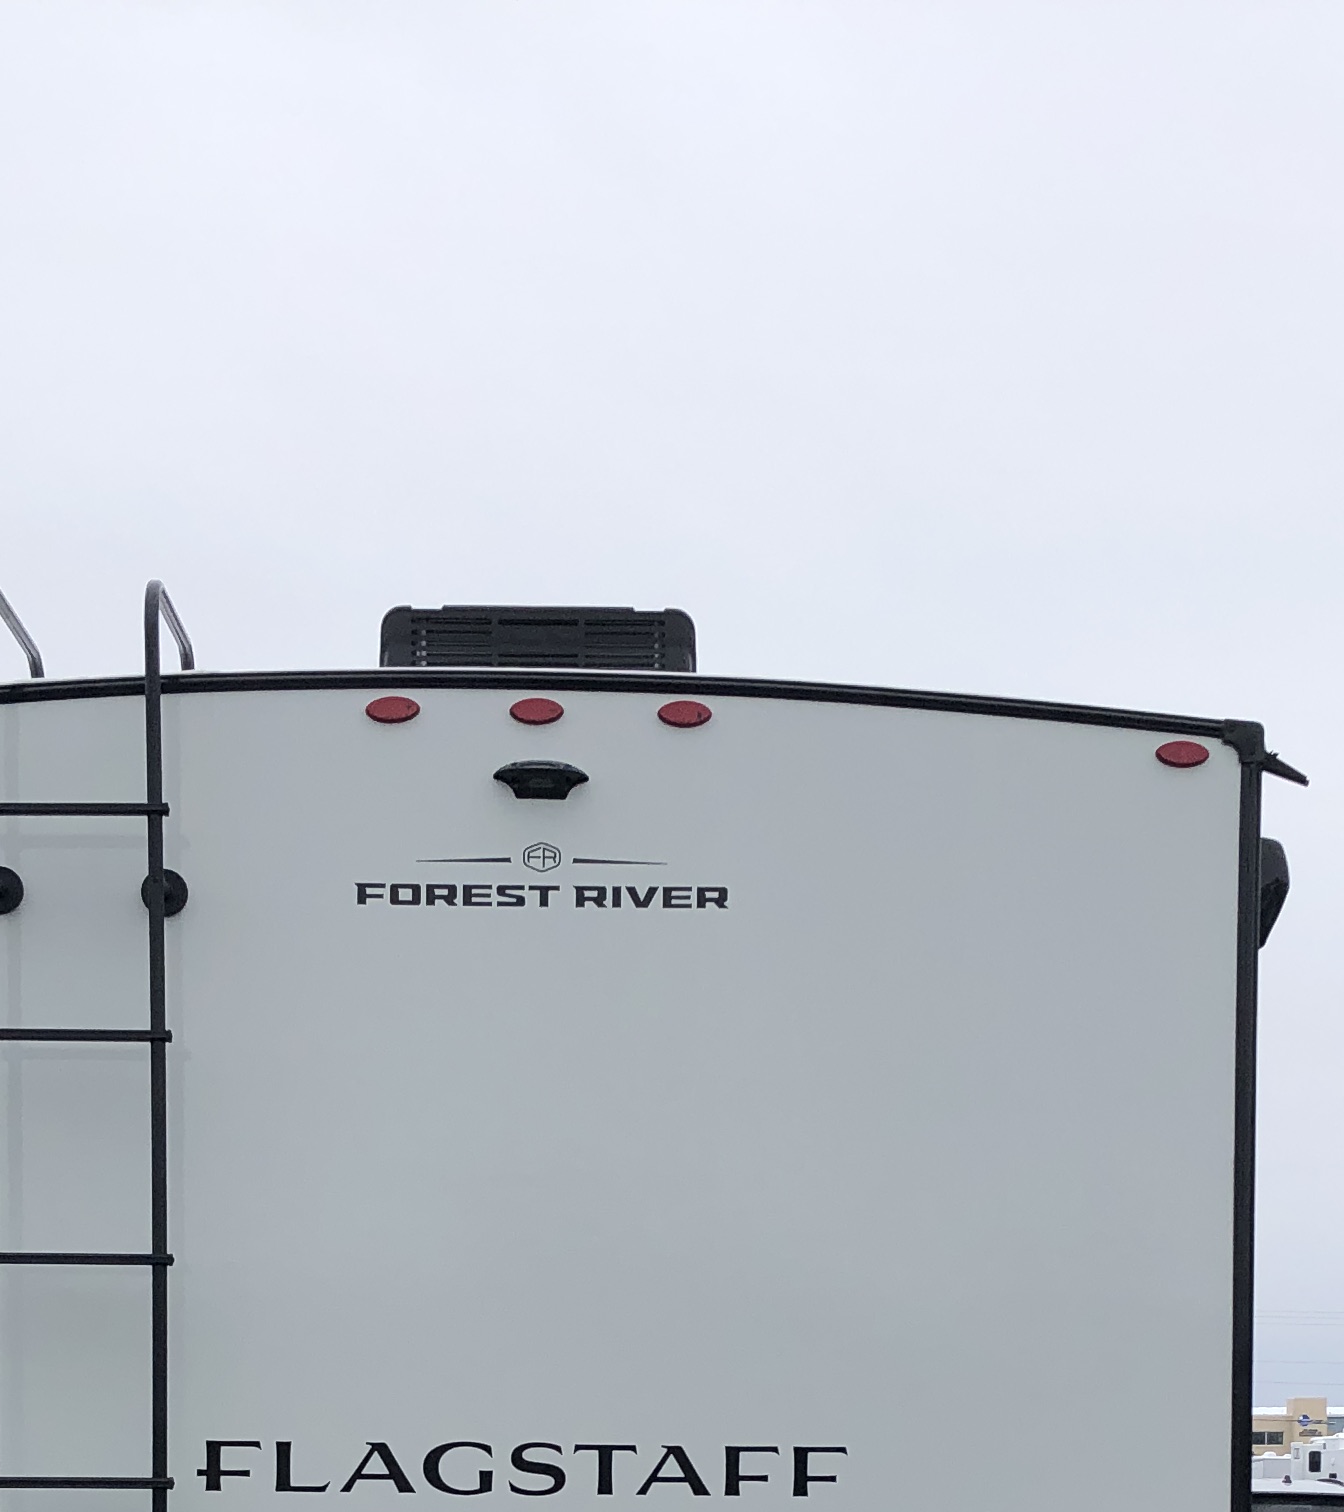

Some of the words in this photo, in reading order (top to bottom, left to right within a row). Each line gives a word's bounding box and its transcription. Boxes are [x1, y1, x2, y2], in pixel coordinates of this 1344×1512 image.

[354, 882, 560, 908] FOREST
[573, 885, 729, 910] RIVER
[197, 1439, 849, 1498] FLAGSTAFF
